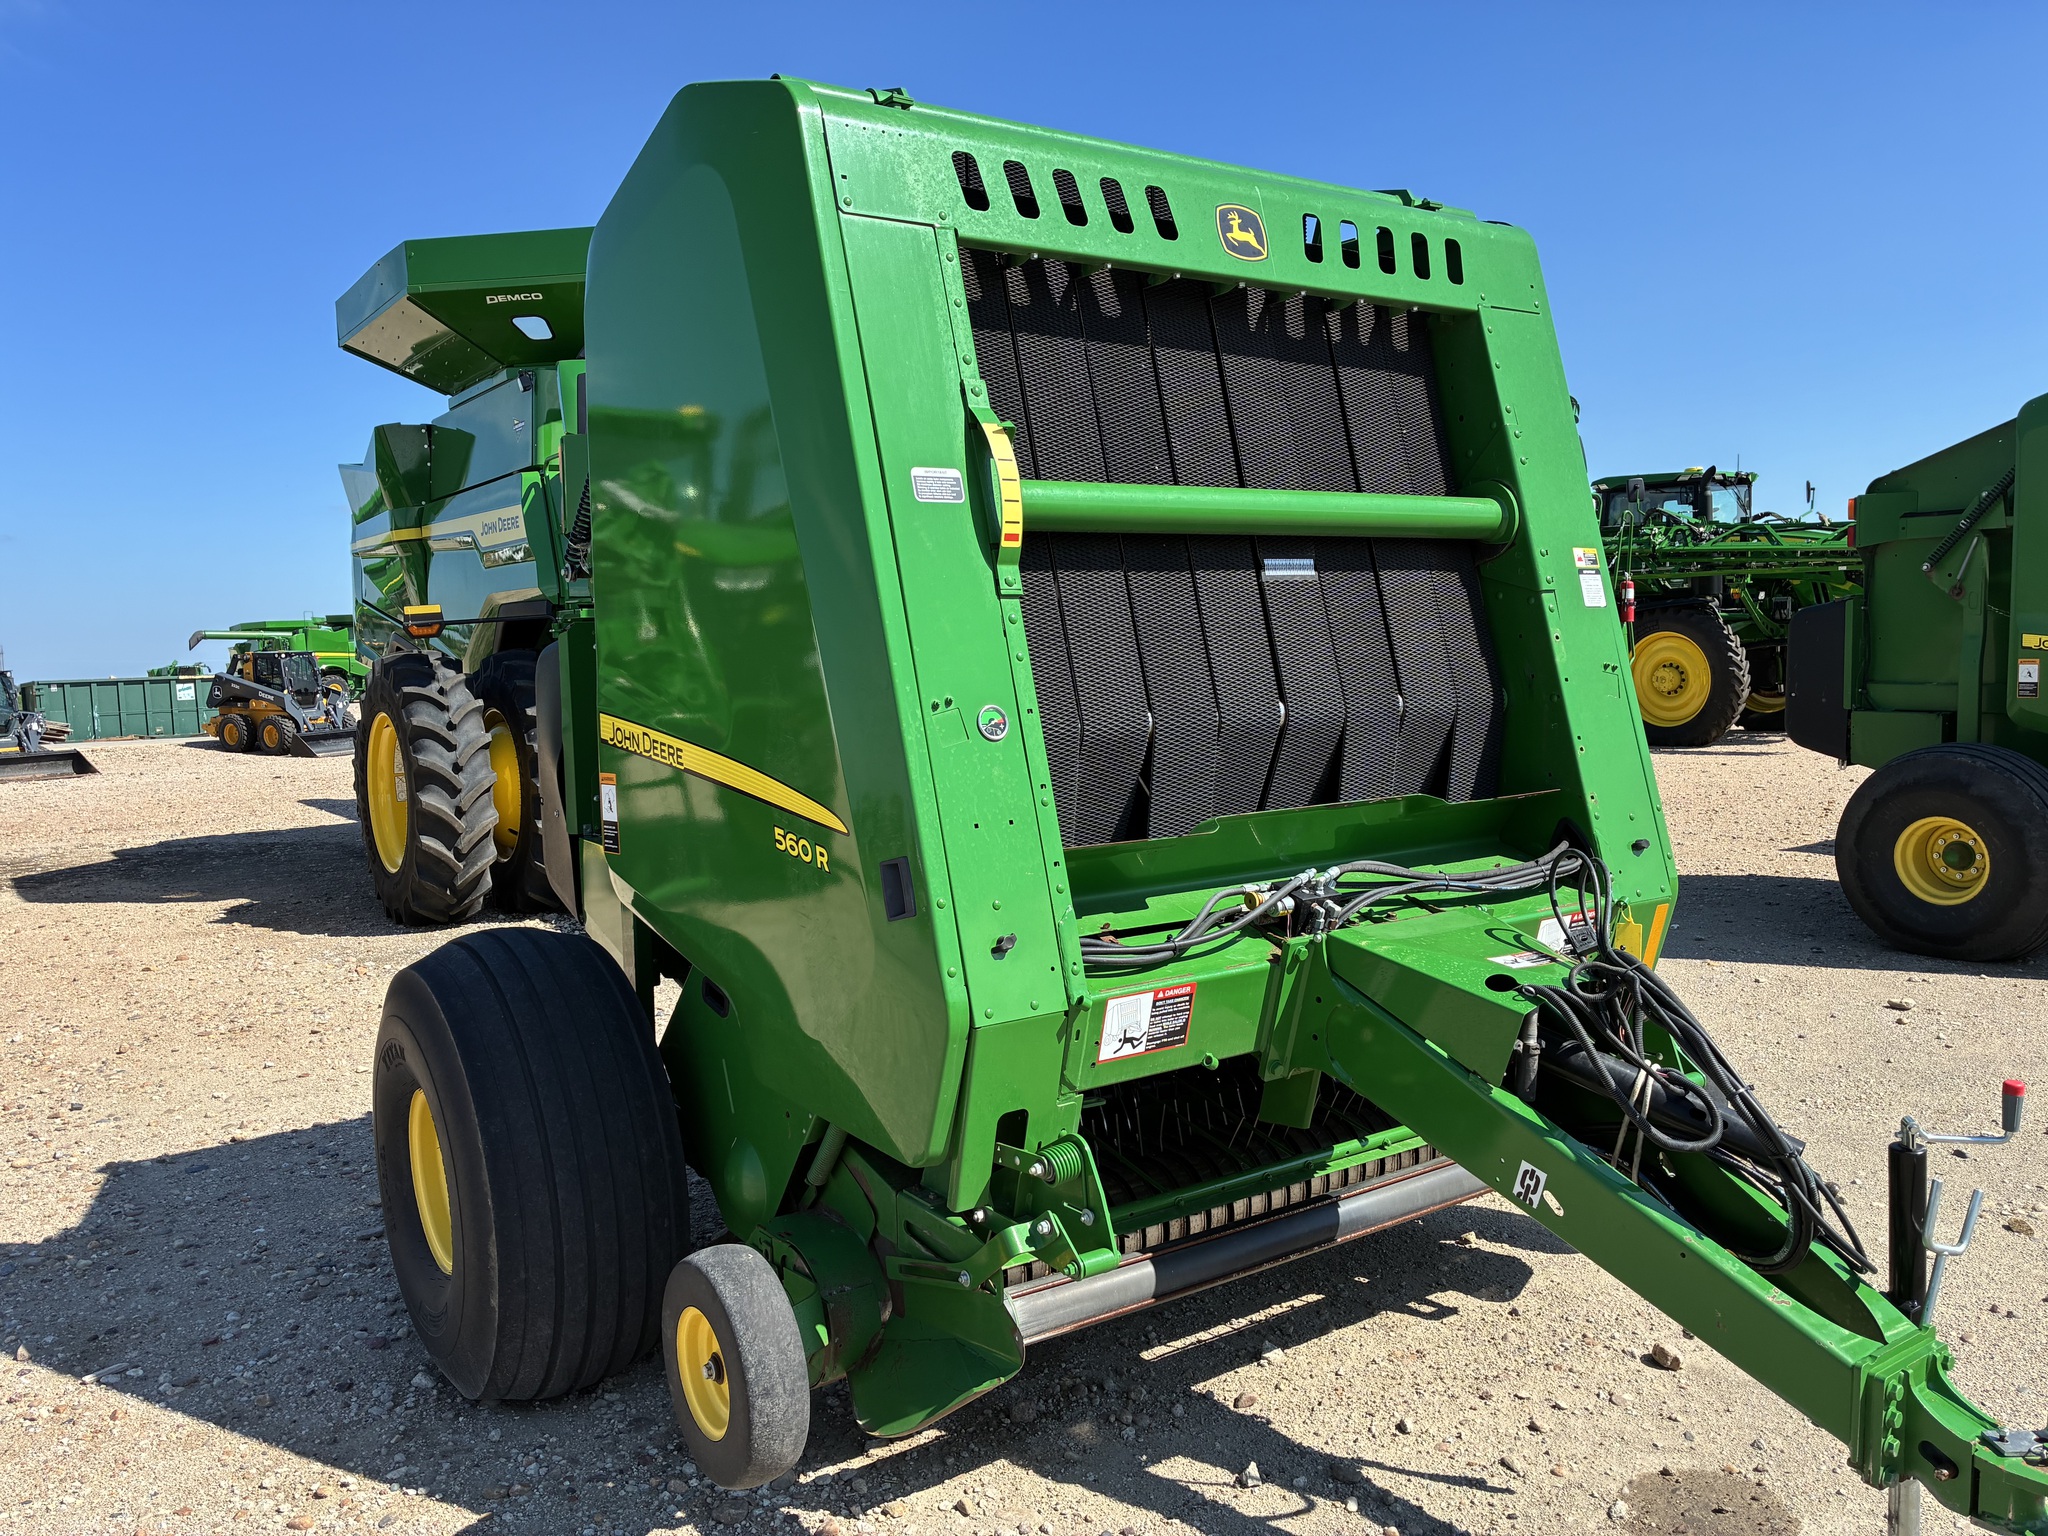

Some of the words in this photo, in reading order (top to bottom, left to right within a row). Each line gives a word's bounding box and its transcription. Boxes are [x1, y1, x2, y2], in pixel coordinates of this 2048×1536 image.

[486, 292, 543, 304] DEMCO
[480, 520, 498, 537] JOHN
[497, 515, 520, 533] DEERE
[258, 690, 275, 701] DEERE
[609, 721, 641, 751] JOHN
[642, 731, 685, 767] DEERE
[773, 825, 813, 864] 560
[815, 843, 831, 874] R
[1164, 986, 1191, 997] DANGER
